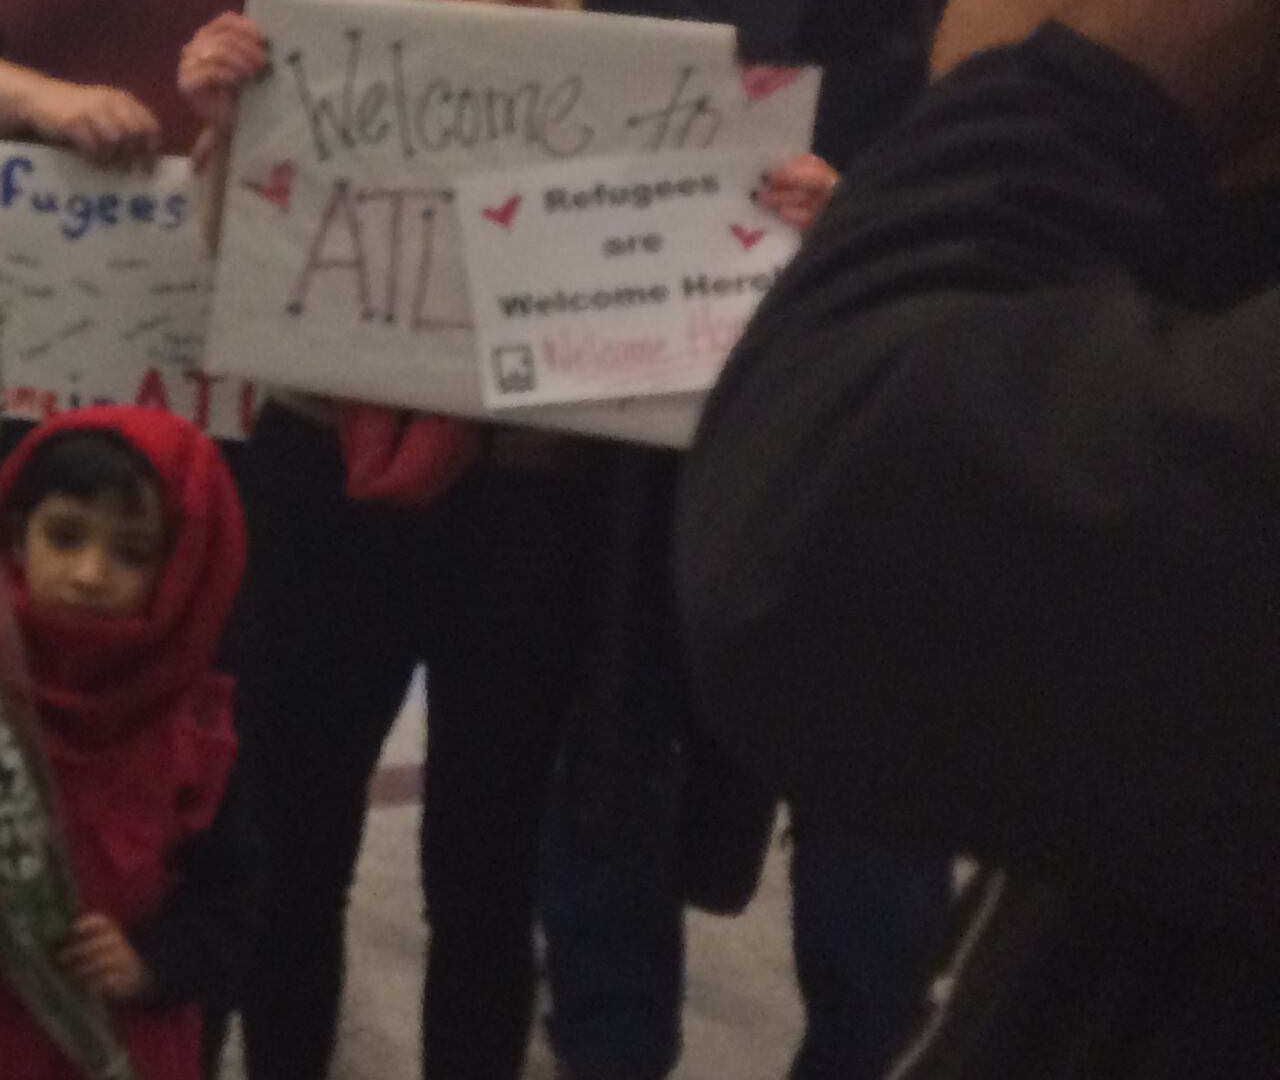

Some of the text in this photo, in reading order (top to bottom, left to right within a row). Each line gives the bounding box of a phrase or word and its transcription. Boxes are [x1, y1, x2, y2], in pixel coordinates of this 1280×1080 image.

[283, 27, 595, 162] Welcome
[544, 175, 719, 213] Refugees
[602, 233, 663, 258] are
[498, 283, 671, 318] Welcome
